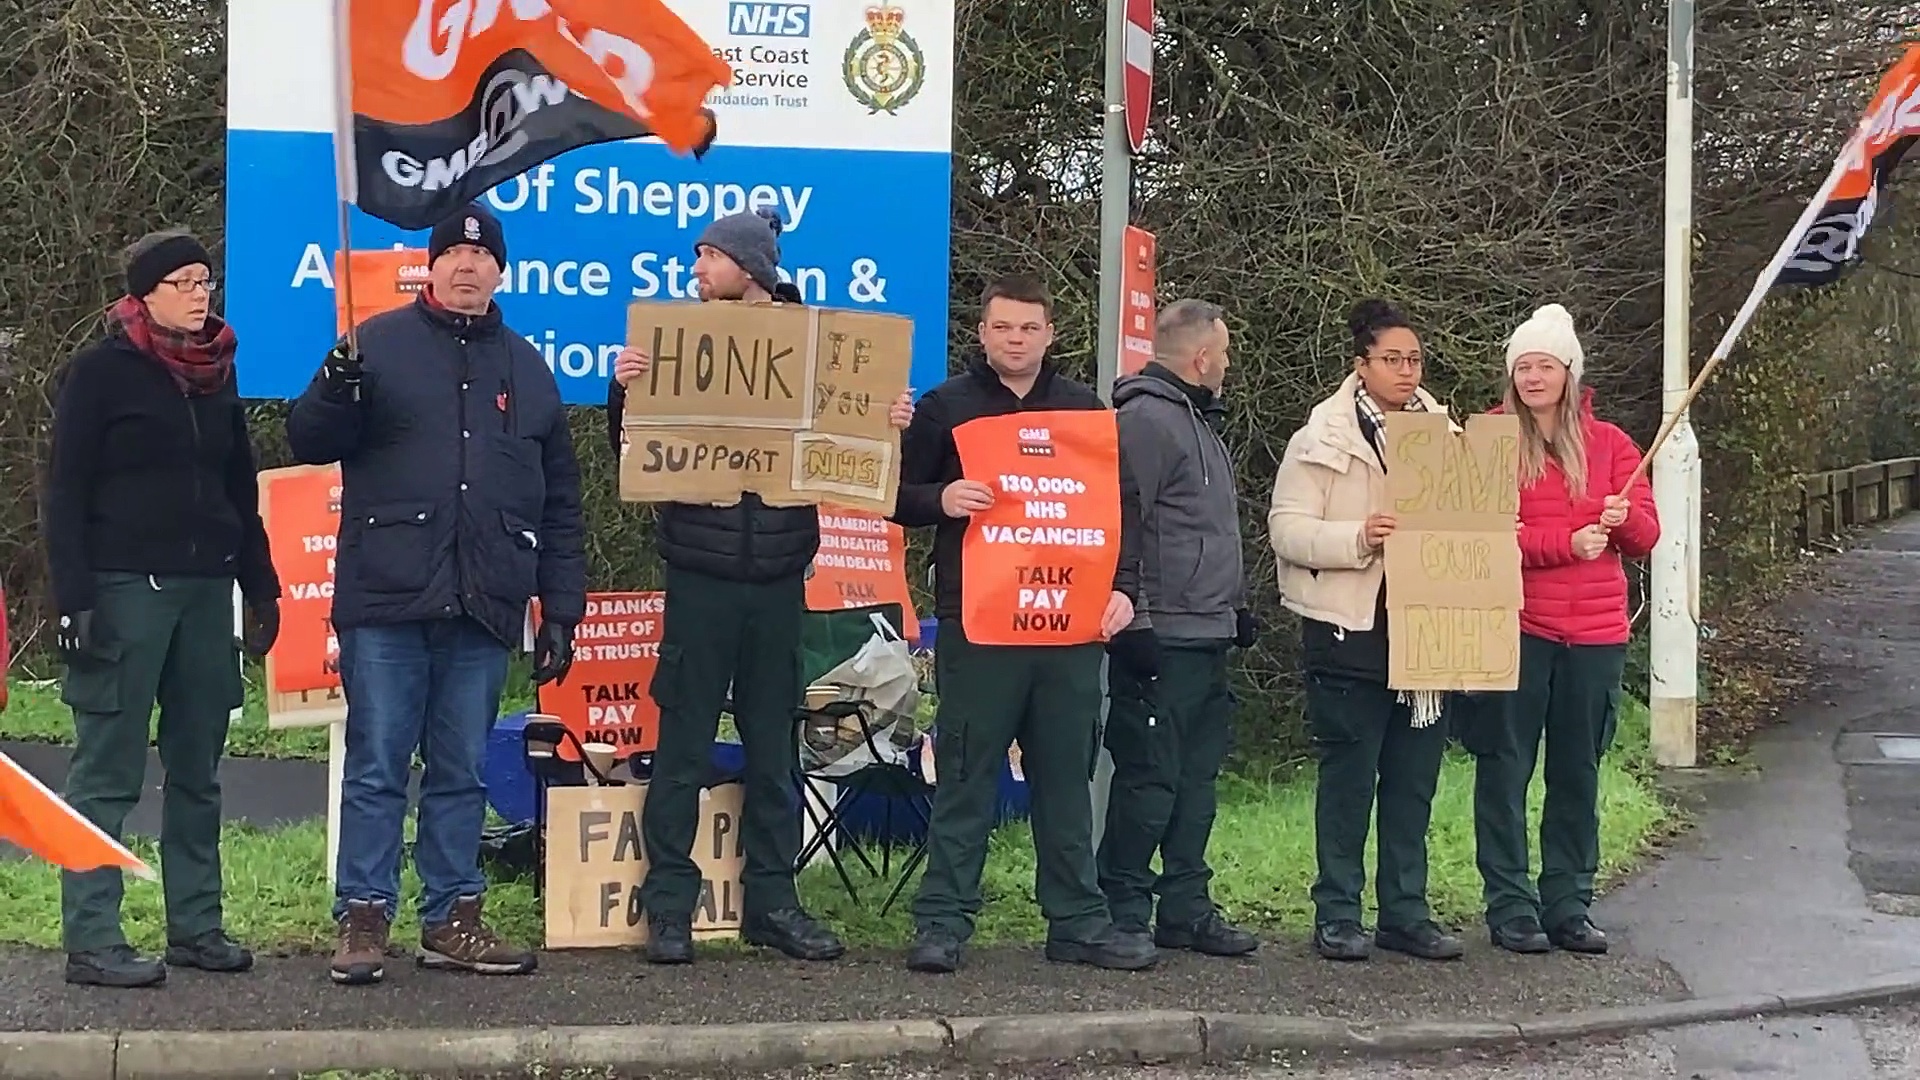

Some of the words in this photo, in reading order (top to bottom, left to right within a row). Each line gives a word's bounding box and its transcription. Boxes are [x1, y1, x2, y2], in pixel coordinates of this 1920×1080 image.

[731, 4, 807, 36] NHS
[713, 47, 742, 62] ast
[750, 46, 809, 64] Coast
[733, 68, 809, 88] Service
[773, 94, 808, 107] Trust
[486, 164, 555, 212] Of
[574, 166, 813, 233] Sheppey
[398, 265, 430, 277] GMB
[848, 258, 887, 303] &
[827, 331, 872, 374] IF
[650, 327, 793, 400] HONK
[642, 440, 780, 473] SUPPORT
[806, 449, 882, 487] NHS
[999, 474, 1086, 496] 130,000+
[1025, 501, 1067, 519] NHS
[981, 525, 1105, 546] VACANCIES
[1420, 533, 1491, 580] OUR
[1015, 566, 1073, 585] TALK
[835, 581, 877, 599] TALK
[1018, 589, 1068, 609] PAY
[601, 597, 665, 616] BANKS
[582, 622, 628, 639] HALF
[630, 620, 655, 636] OF
[1012, 613, 1071, 631] NOW
[581, 682, 641, 703] TALK
[588, 703, 637, 726] PAY
[584, 727, 642, 745] NOW
